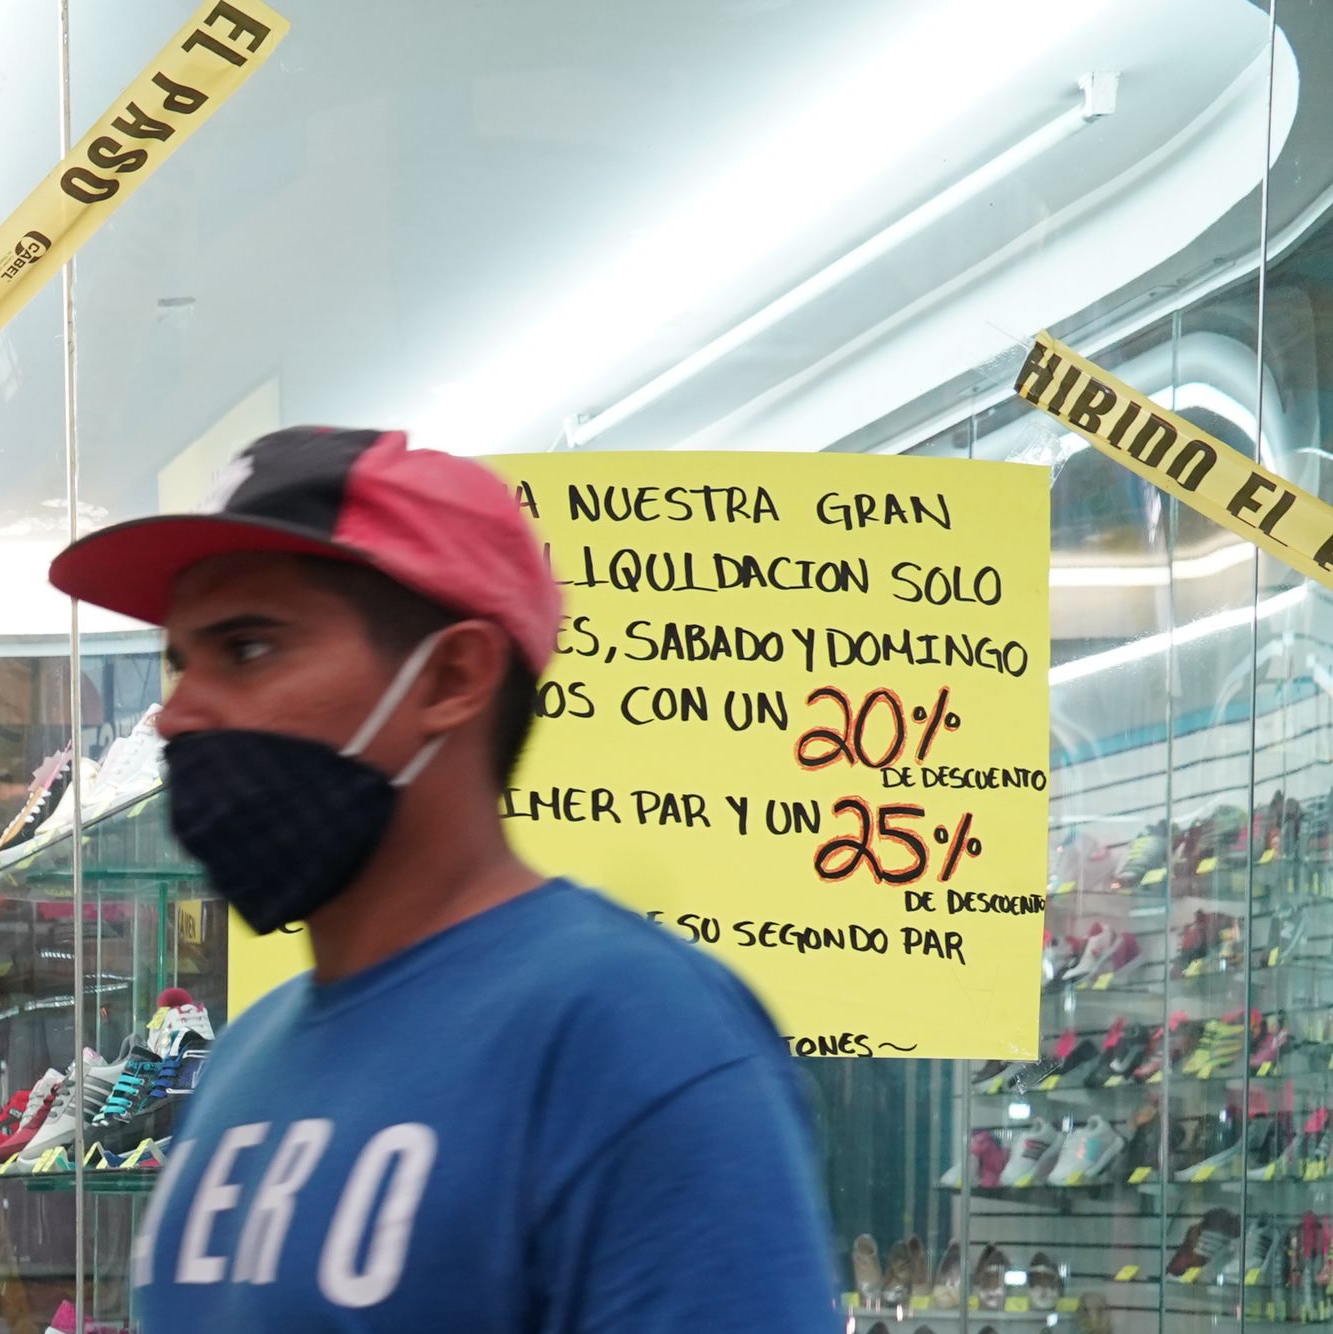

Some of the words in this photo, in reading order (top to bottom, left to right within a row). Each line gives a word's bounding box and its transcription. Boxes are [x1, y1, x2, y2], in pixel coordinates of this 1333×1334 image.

[181, 0, 271, 67] EL
[60, 72, 209, 204] PASO
[568, 484, 780, 524] NUESTRA
[816, 491, 952, 530] GRAN
[892, 563, 1002, 605] SOLO
[624, 620, 784, 664] SABADO
[792, 628, 816, 672] Y
[827, 628, 1029, 677] DOMINGO
[621, 685, 707, 725] CON
[724, 691, 788, 731] UN
[795, 686, 961, 771] 20%
[881, 768, 916, 789] DE
[922, 768, 1046, 791] DESCUENTO
[630, 792, 711, 828] PAR
[727, 796, 748, 835] Y
[766, 799, 821, 835] UN
[814, 795, 982, 885] 25%
[905, 891, 936, 913] DE
[948, 890, 1046, 915] DESCUENTO
[677, 914, 721, 944] SU
[901, 927, 966, 965] PAR
